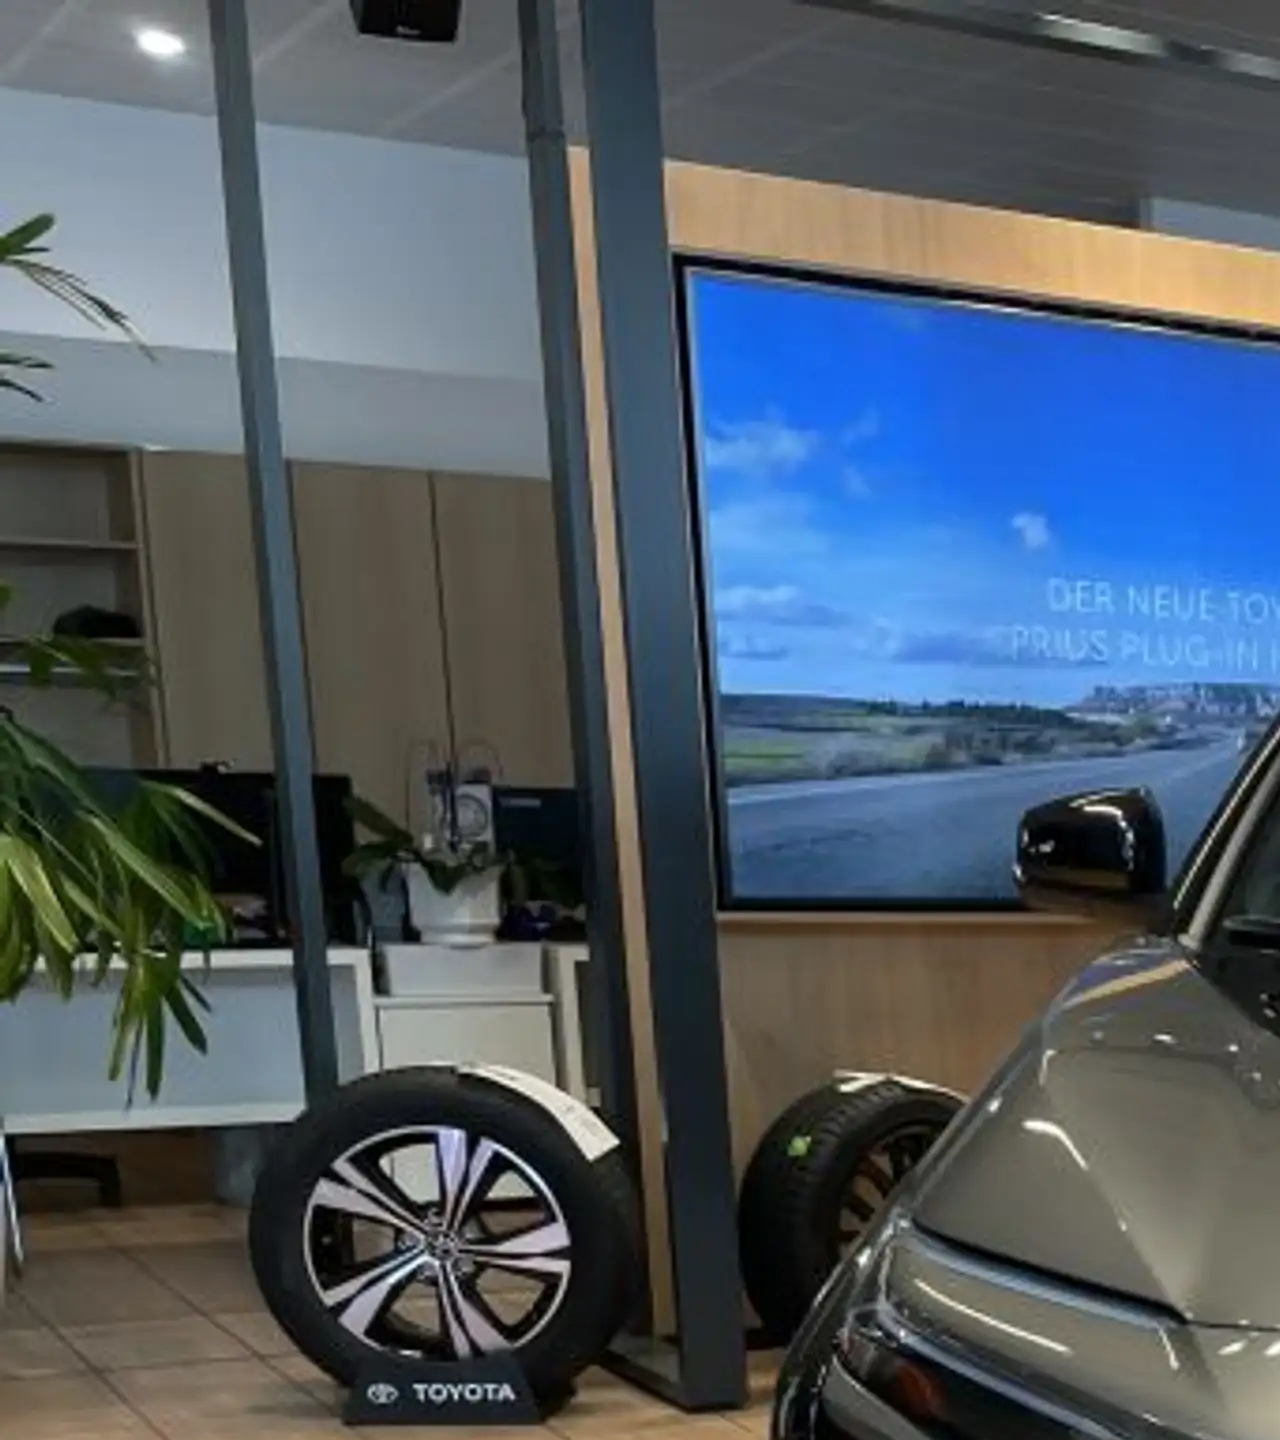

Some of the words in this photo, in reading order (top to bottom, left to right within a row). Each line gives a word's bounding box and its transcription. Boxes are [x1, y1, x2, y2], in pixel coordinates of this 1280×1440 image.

[1047, 576, 1115, 614] DER
[1128, 583, 1216, 622] NEUE
[1011, 625, 1109, 662] PRIUS
[412, 1382, 517, 1404] TOYOTA
